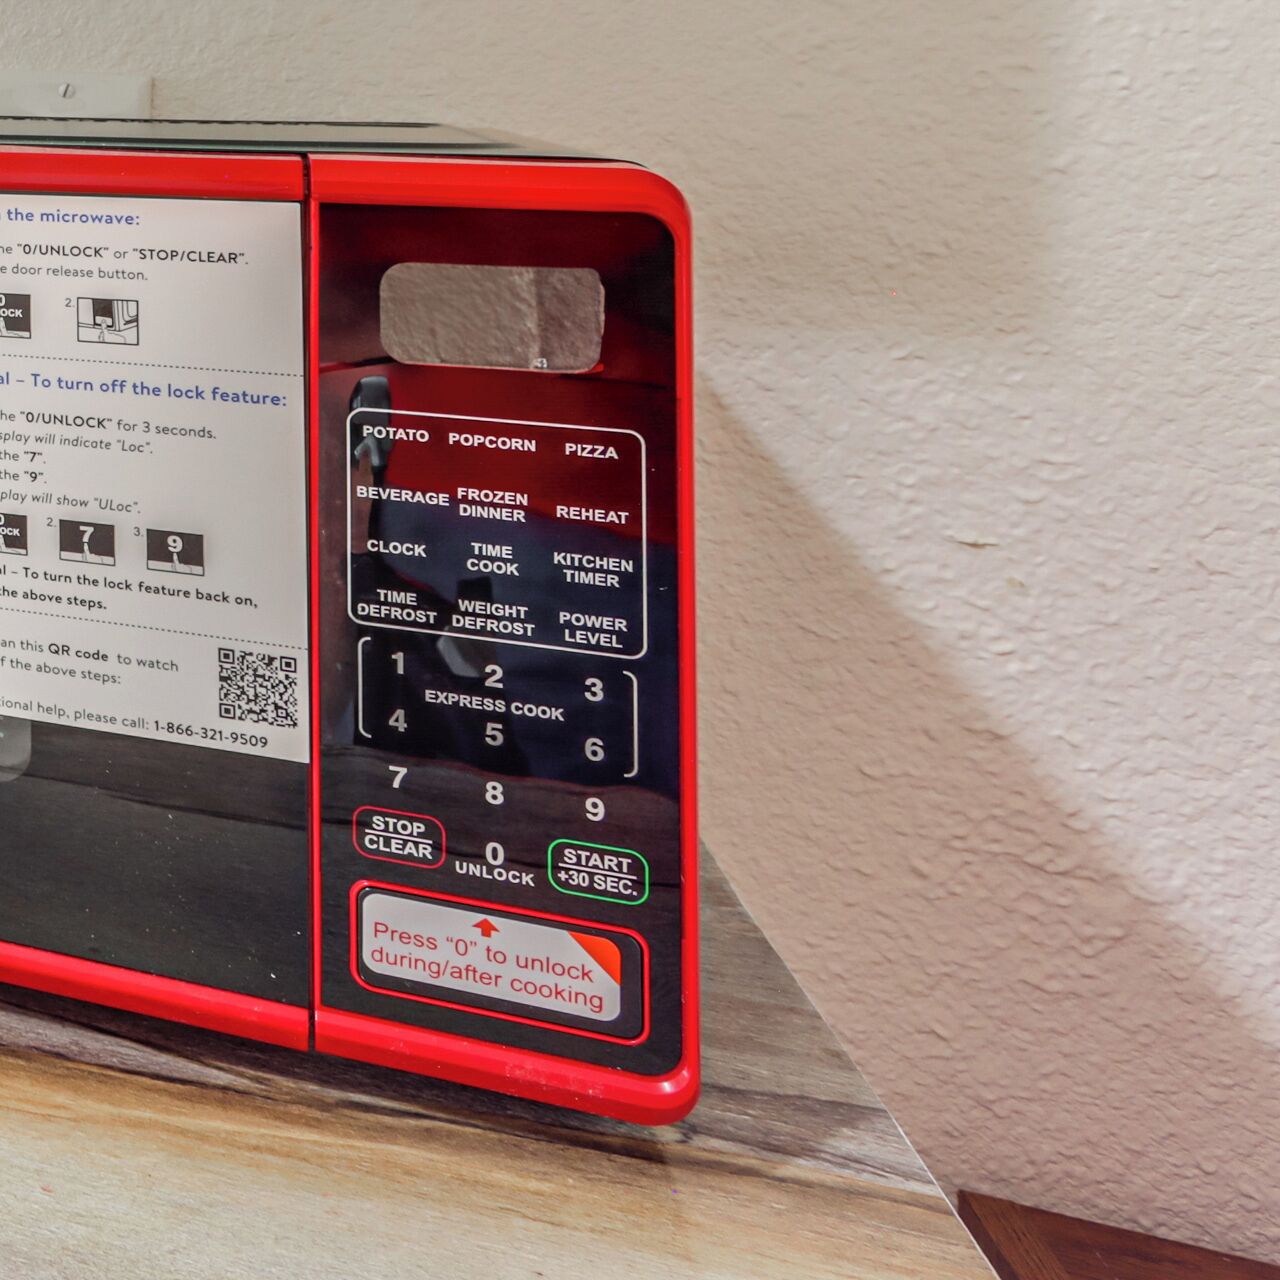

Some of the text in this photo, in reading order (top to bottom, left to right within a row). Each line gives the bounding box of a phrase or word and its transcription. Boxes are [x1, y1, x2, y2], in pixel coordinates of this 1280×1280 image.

[7, 208, 34, 221] the
[40, 209, 140, 225] microwave:
[17, 244, 109, 258] "0/UNLOCK"
[114, 251, 128, 259] or
[133, 248, 249, 265] "STOP/CLEAR".
[12, 264, 42, 276] door
[46, 266, 94, 278] release
[98, 268, 148, 281] button.
[30, 373, 51, 388] To
[57, 377, 94, 391] turn
[99, 379, 127, 394] off
[132, 381, 161, 396] the
[167, 383, 205, 400] lock
[211, 387, 287, 407] feature:
[20, 411, 112, 429] "0/UNLOCK"
[117, 419, 138, 432] for
[142, 421, 151, 433] 3
[155, 424, 217, 439] seconds.
[362, 425, 430, 443] POTATO
[35, 433, 56, 445] will
[59, 434, 112, 450] indicate
[448, 432, 536, 452] POPCORN
[565, 443, 619, 460] PIZZA
[32, 492, 52, 505] will
[56, 495, 89, 508] show
[356, 485, 450, 507] BEVERAGE
[457, 487, 529, 506] FROZEN
[459, 503, 526, 523] DINNER
[556, 505, 629, 524] REHEAT
[79, 525, 95, 543] 7
[166, 535, 183, 553] 9
[366, 539, 427, 558] CLOCK
[471, 542, 513, 559] TIME
[466, 558, 520, 577] COOK
[553, 551, 634, 573] KITCHEN
[23, 566, 39, 579] To
[43, 570, 72, 584] turn
[76, 574, 100, 587] the
[104, 577, 132, 591] lock
[138, 581, 191, 598] feature
[196, 588, 229, 603] back
[234, 596, 258, 609] on,
[563, 569, 620, 588] TIMER
[22, 589, 62, 604] above
[67, 597, 107, 611] steps.
[376, 589, 417, 606] TIME
[458, 598, 528, 619] WEIGHT
[357, 603, 438, 625] DEFROST
[559, 611, 628, 632] POWER
[451, 614, 536, 638] DEFROST
[564, 628, 624, 649] LEVEL
[20, 640, 44, 653] this
[48, 643, 70, 657] QR
[75, 648, 109, 662] code
[117, 654, 132, 665] to
[136, 658, 179, 672] watch
[391, 651, 406, 675] 1
[10, 658, 32, 671] the
[36, 662, 77, 678] above
[81, 669, 122, 685] steps:
[485, 664, 504, 689] 2
[584, 677, 605, 702] 3
[424, 689, 565, 721] EXPRESS COOK
[37, 702, 70, 720] help,
[74, 708, 117, 726] please
[122, 717, 149, 730] call:
[154, 720, 268, 748] 1-866-321-9509
[388, 709, 408, 732] 4
[485, 722, 504, 747] 5
[584, 737, 606, 762] 6
[388, 765, 408, 789] 7
[485, 781, 505, 805] 8
[585, 797, 605, 822] 9
[372, 815, 426, 837] STOP
[364, 834, 433, 859] CLEAR
[485, 842, 504, 866] 0
[563, 848, 632, 873] START
[455, 860, 535, 887] UNLOCK
[557, 870, 638, 897] +30 SEC.
[373, 921, 438, 950] Press
[485, 945, 507, 965] to
[516, 952, 594, 983] unlock
[371, 946, 603, 1013] during/after cooking
